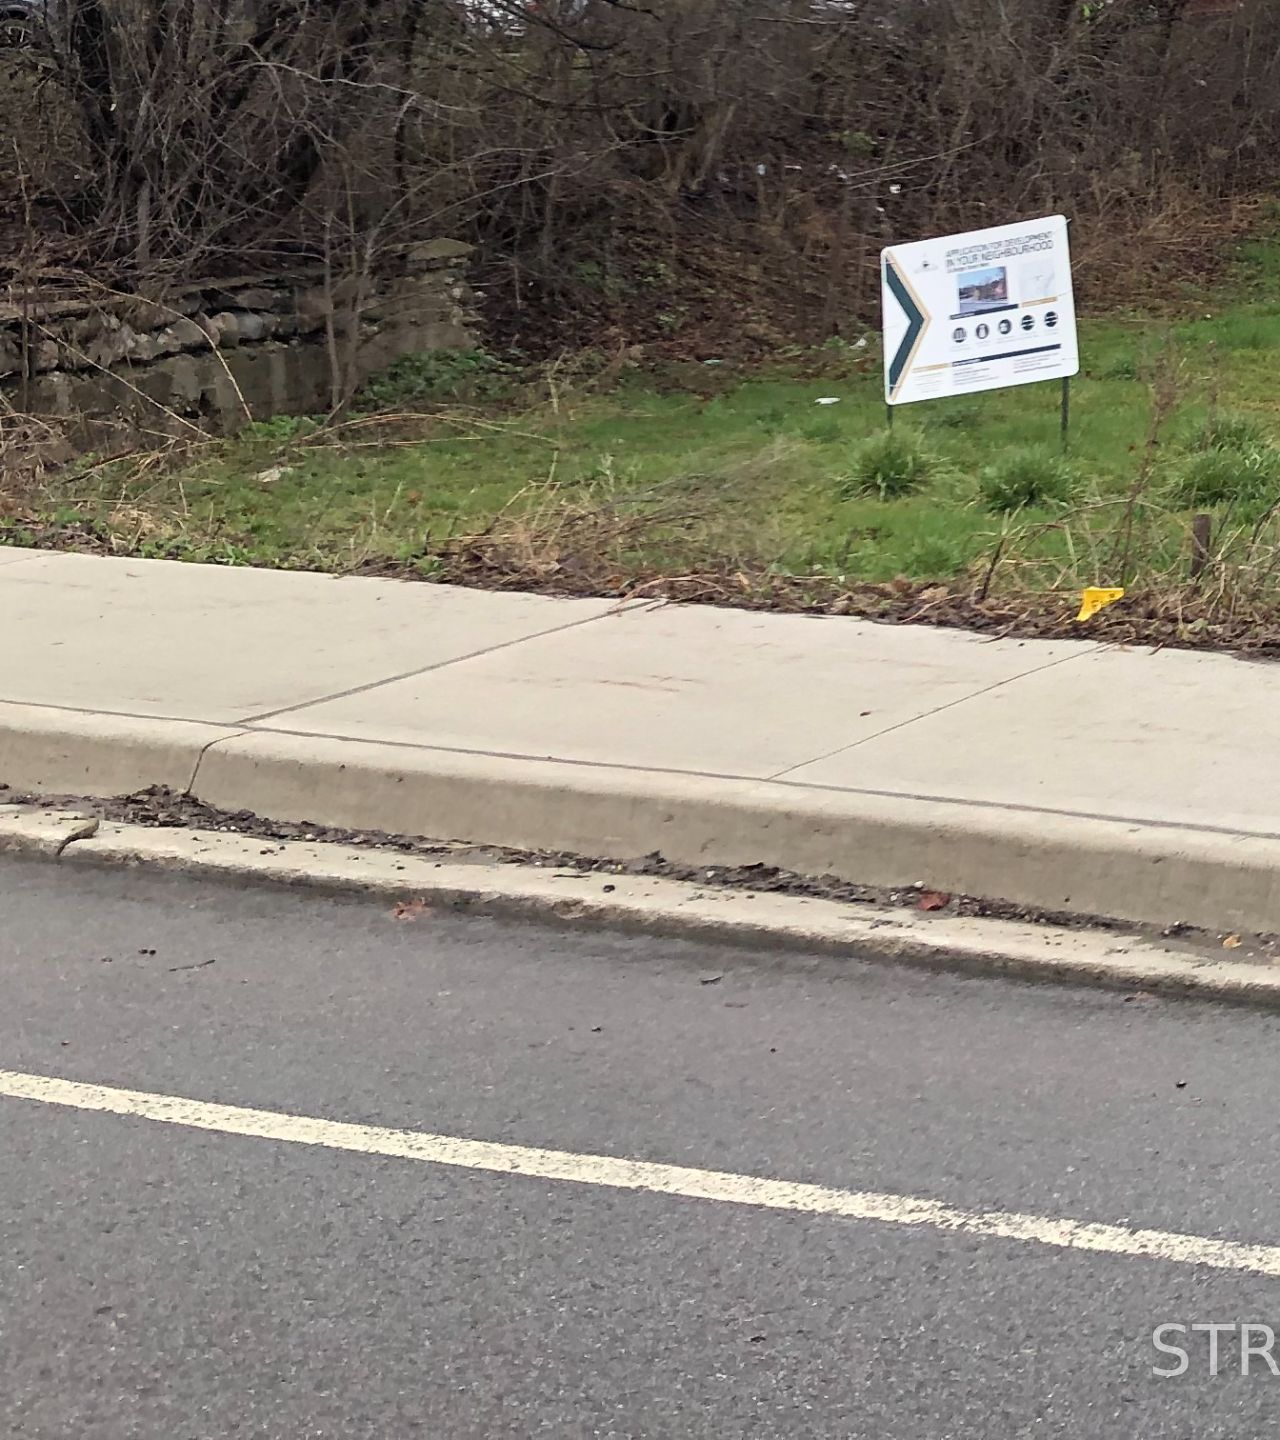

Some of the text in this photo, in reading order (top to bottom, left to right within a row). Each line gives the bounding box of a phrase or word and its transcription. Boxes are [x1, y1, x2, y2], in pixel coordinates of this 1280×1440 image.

[946, 244, 987, 257] APPLICATION
[1005, 231, 1053, 247] DEVELOPMENT
[957, 253, 978, 265] YOUR
[982, 240, 1054, 261] NEIGHBOURHOOD
